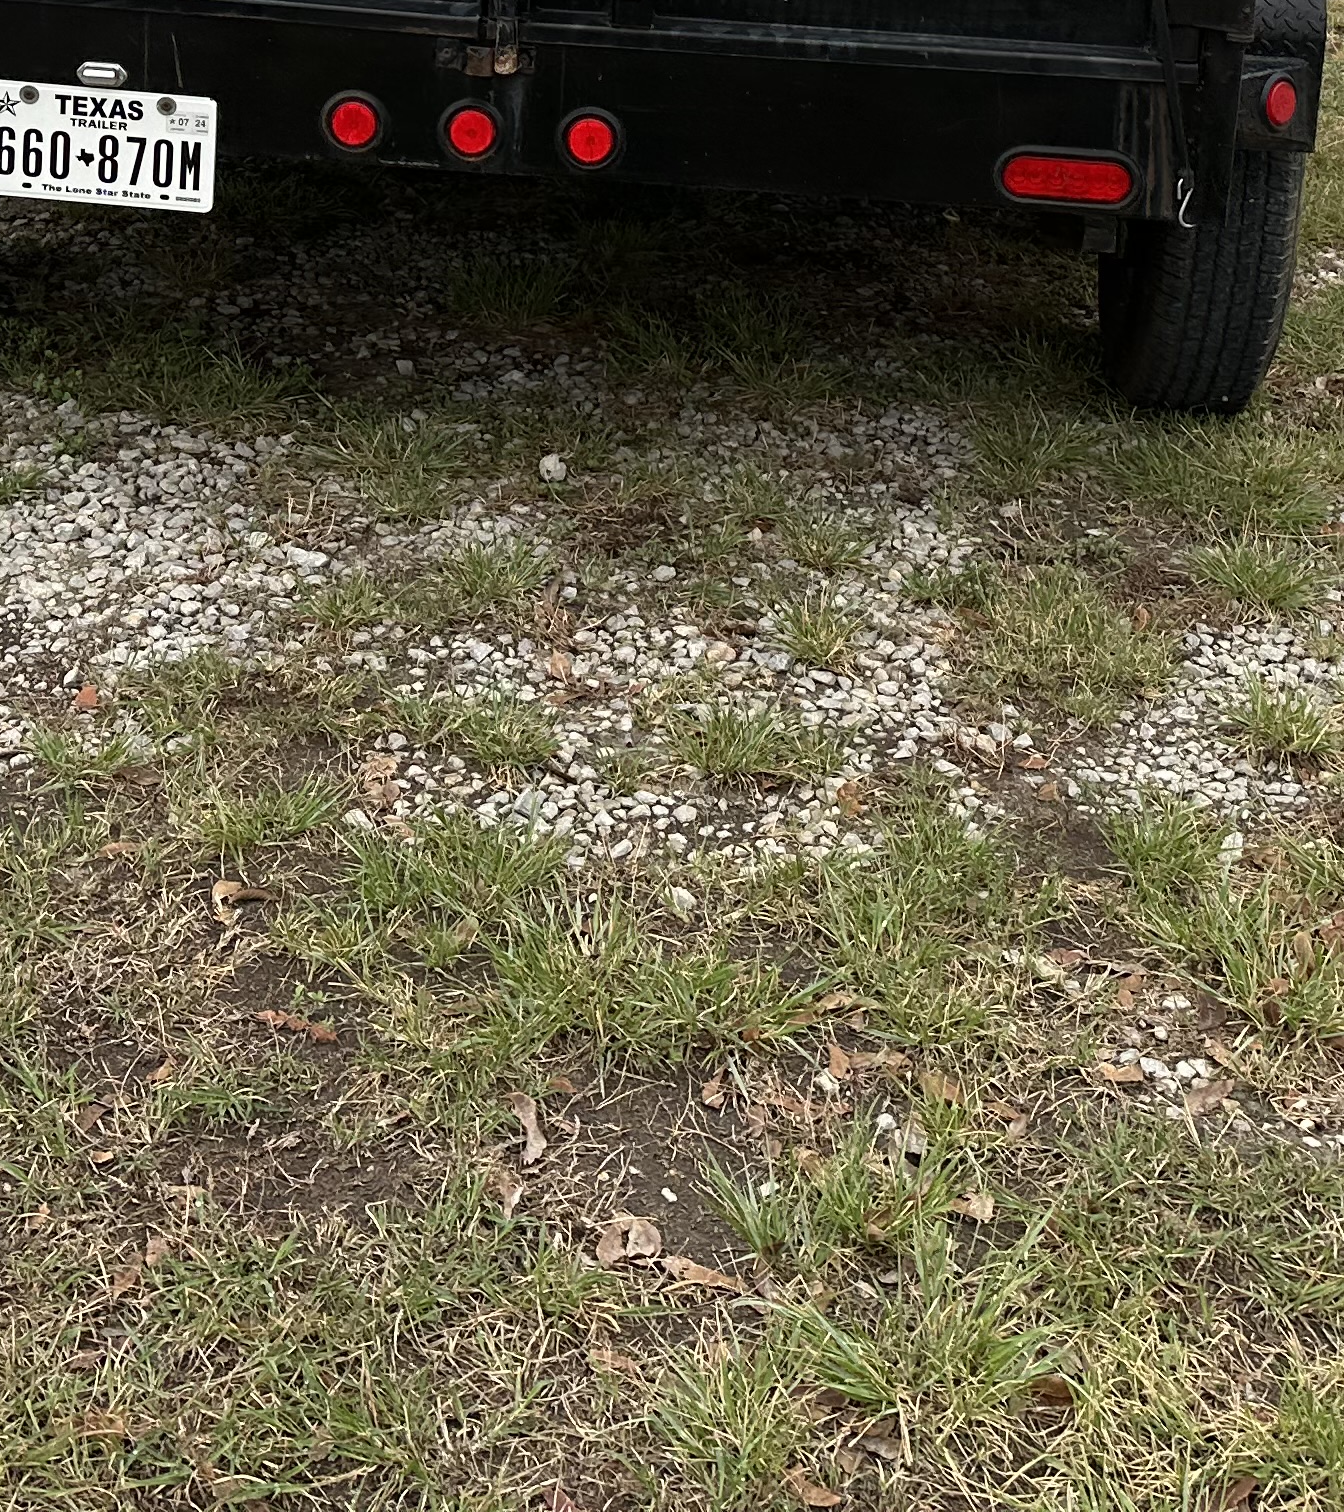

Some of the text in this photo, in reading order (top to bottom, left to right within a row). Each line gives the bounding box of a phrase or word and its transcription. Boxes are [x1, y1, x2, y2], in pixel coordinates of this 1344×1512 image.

[54, 94, 144, 121] TEXAS
[69, 117, 128, 132] TRAILER
[178, 117, 190, 126] 07
[41, 183, 152, 200] The Lone Star State
